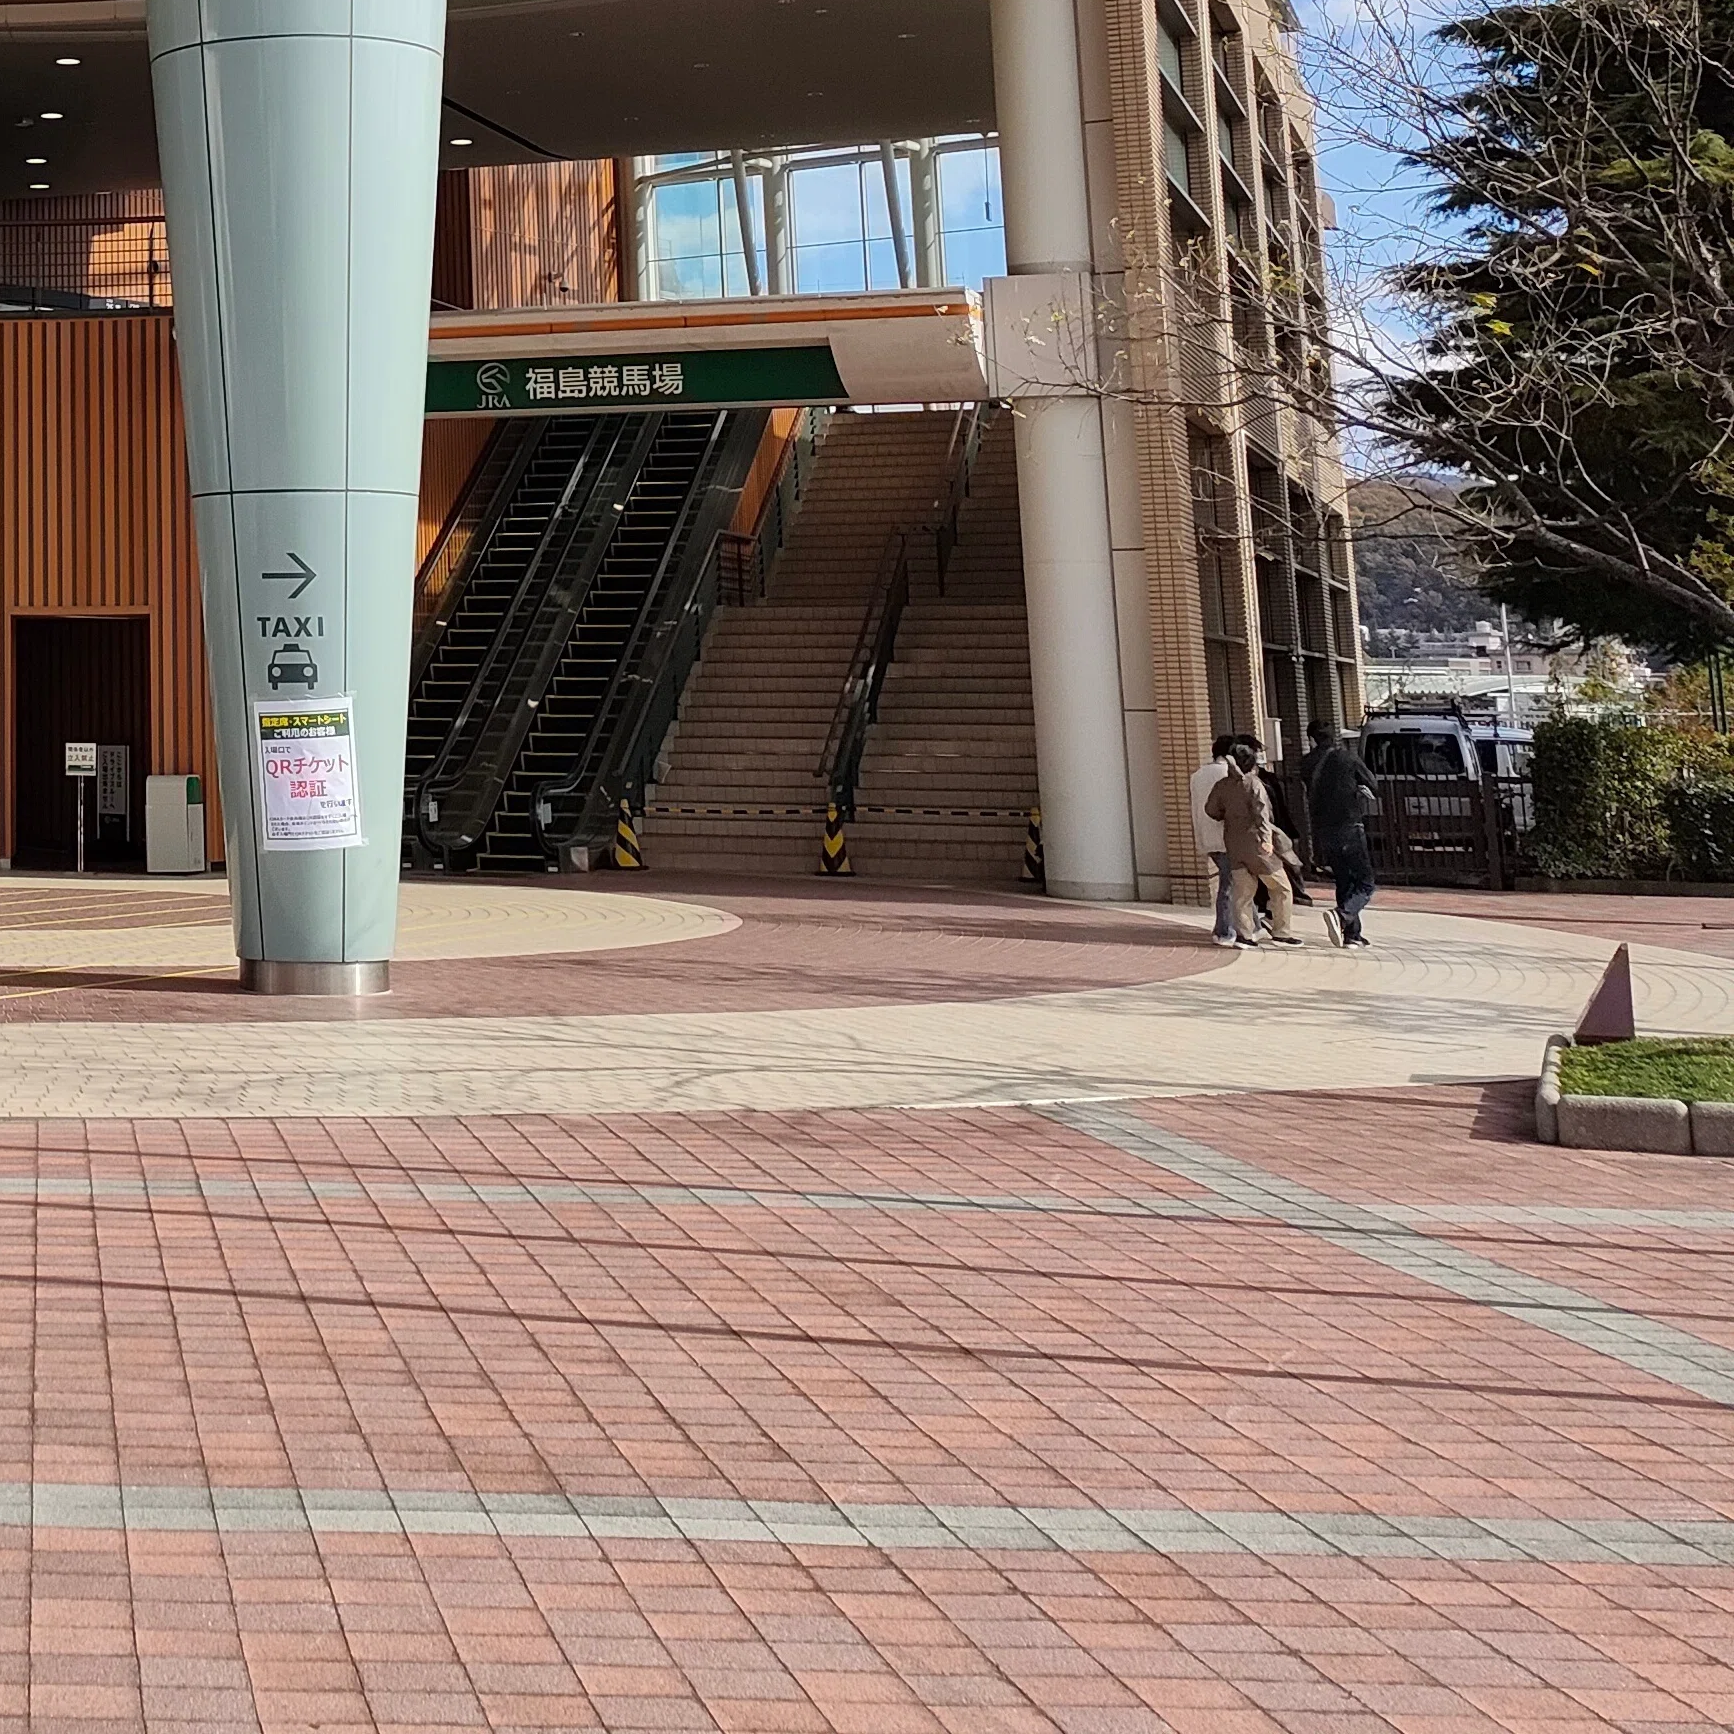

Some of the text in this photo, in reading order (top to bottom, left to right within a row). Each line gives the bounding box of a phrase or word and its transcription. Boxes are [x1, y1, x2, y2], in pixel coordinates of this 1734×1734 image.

[525, 362, 684, 400] 福島競馬場
[476, 394, 511, 408] JRA
[256, 616, 324, 637] TAXI
[67, 754, 94, 762] 立入禁止
[265, 754, 349, 778] QRチケット
[289, 779, 328, 799] 認証
